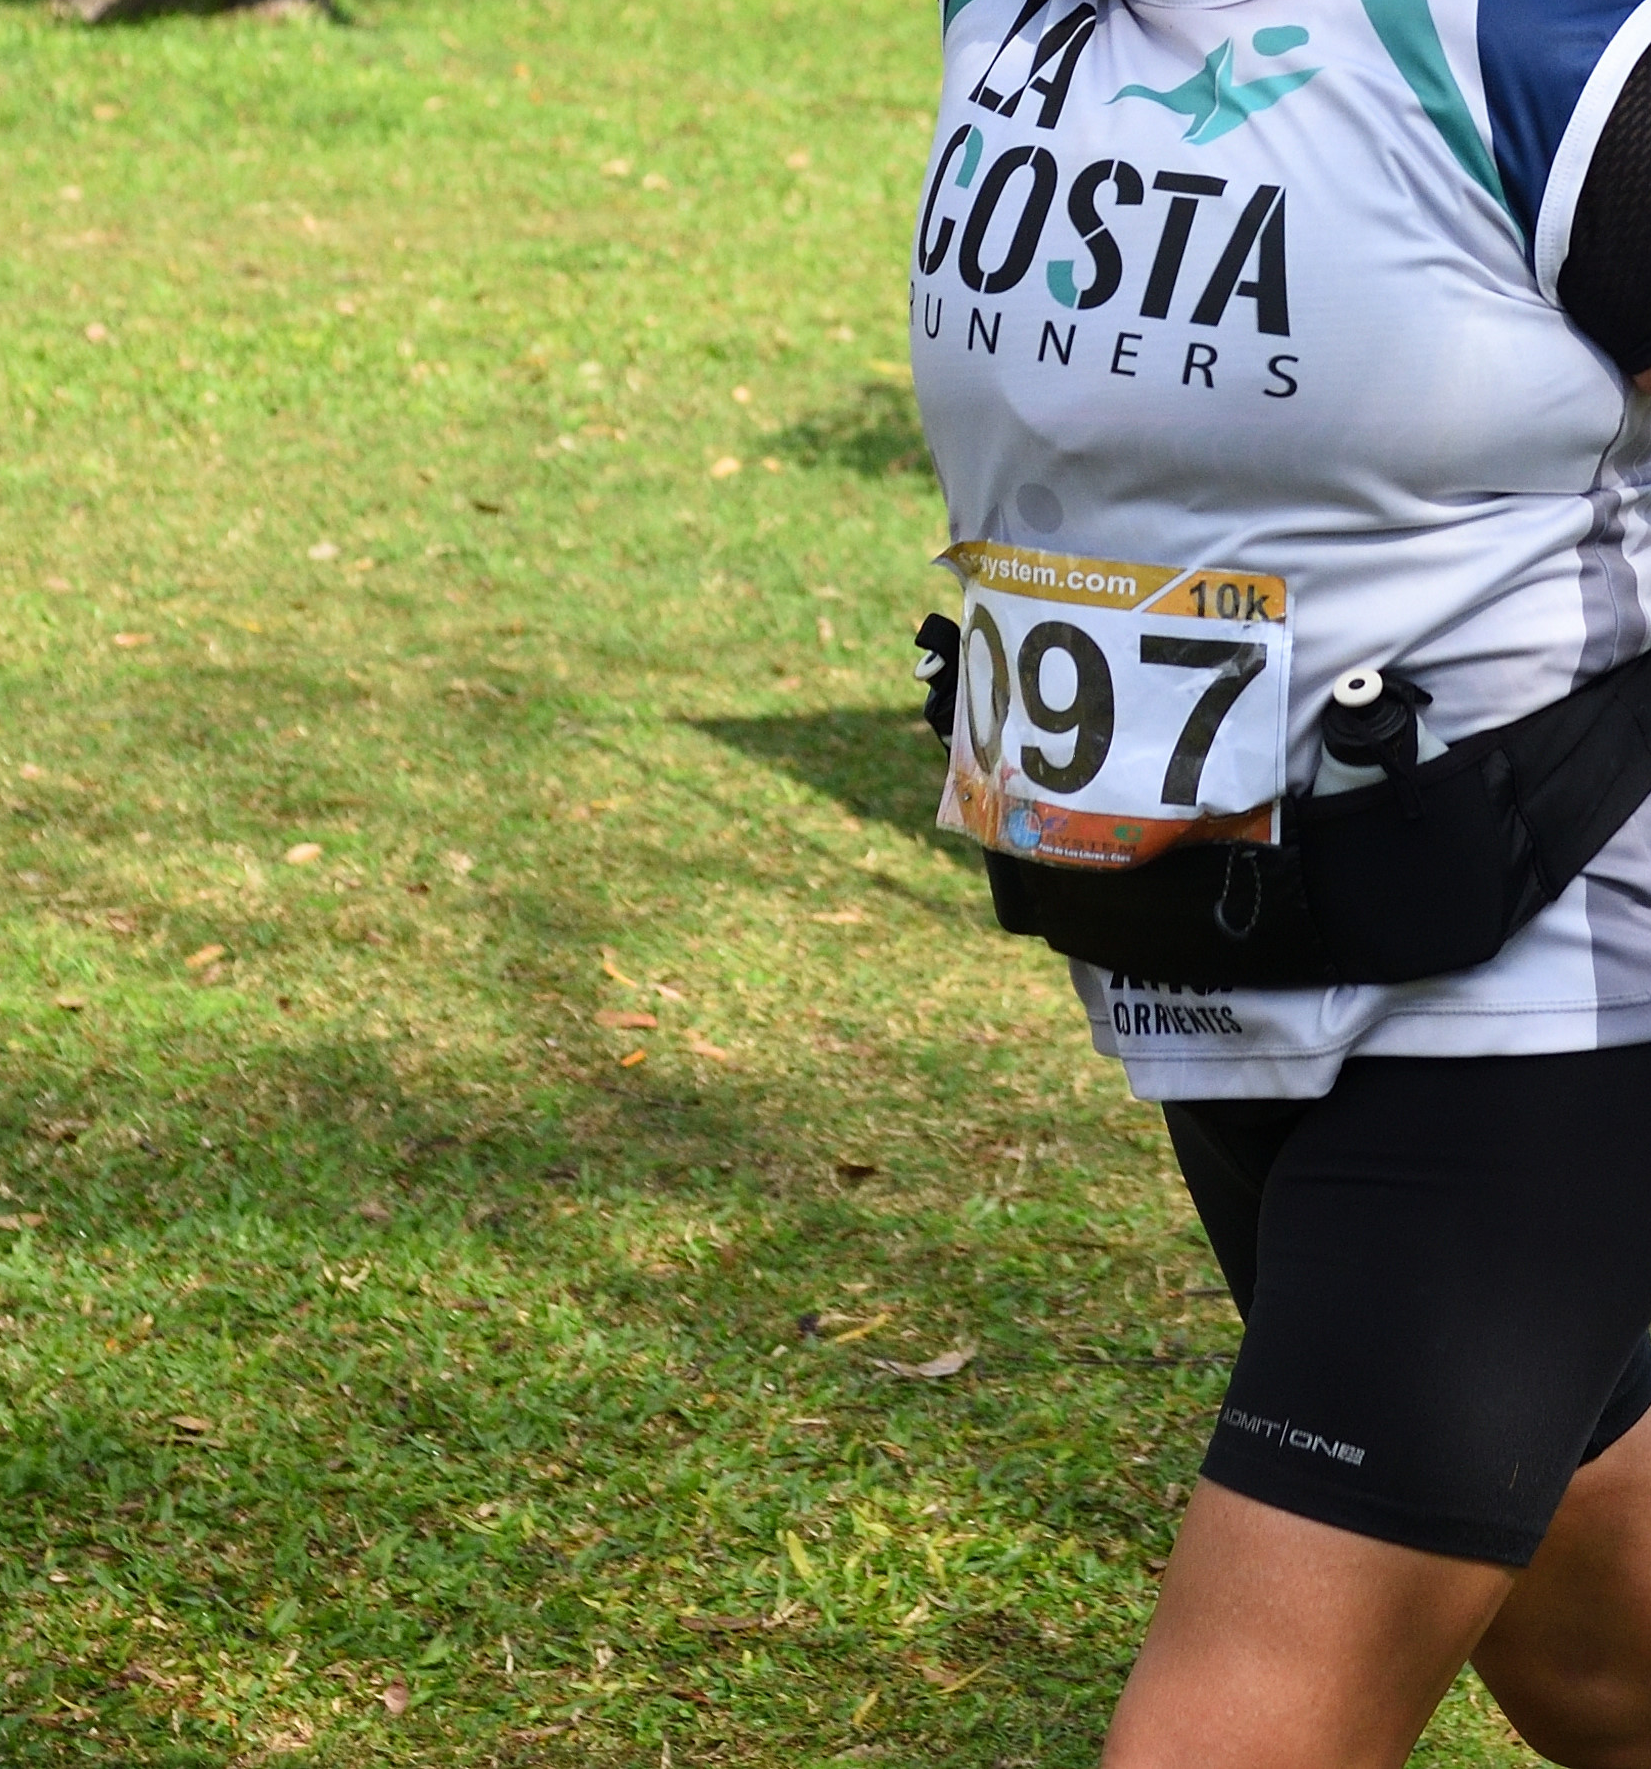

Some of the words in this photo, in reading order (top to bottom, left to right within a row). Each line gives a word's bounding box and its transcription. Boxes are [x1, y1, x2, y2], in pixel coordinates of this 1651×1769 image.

[919, 123, 1292, 338] COSTA
[1189, 579, 1272, 623] 10k
[963, 603, 1268, 807] 097
